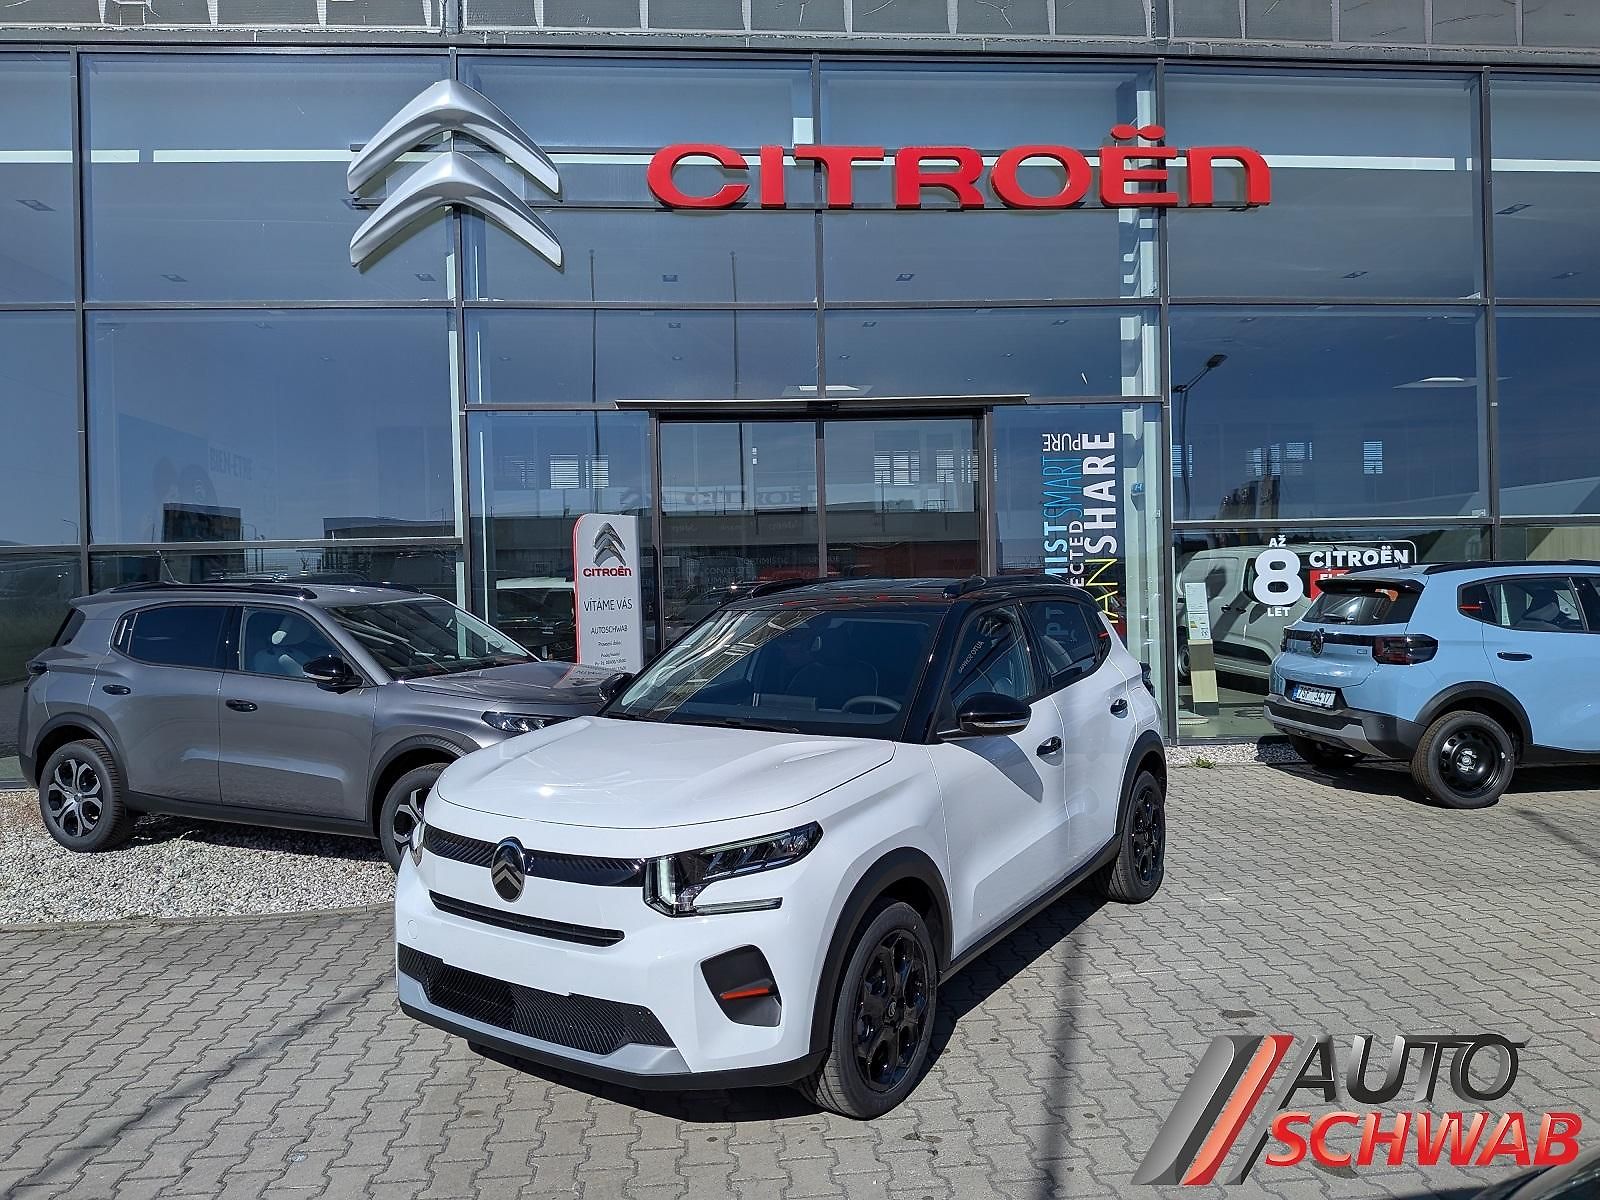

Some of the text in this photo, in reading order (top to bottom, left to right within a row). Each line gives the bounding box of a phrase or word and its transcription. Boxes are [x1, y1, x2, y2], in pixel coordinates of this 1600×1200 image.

[646, 124, 1272, 209] CITROËN
[1042, 433, 1081, 452] PURE
[1043, 456, 1082, 518] SMART
[1081, 432, 1117, 554] SHARE
[1269, 535, 1287, 547] AŽ
[1309, 546, 1409, 568] CITROËN
[583, 566, 632, 577] CITROËN
[1253, 548, 1304, 605] 8
[584, 597, 633, 612] VÍTÁME VÁS
[1267, 607, 1291, 617] LET
